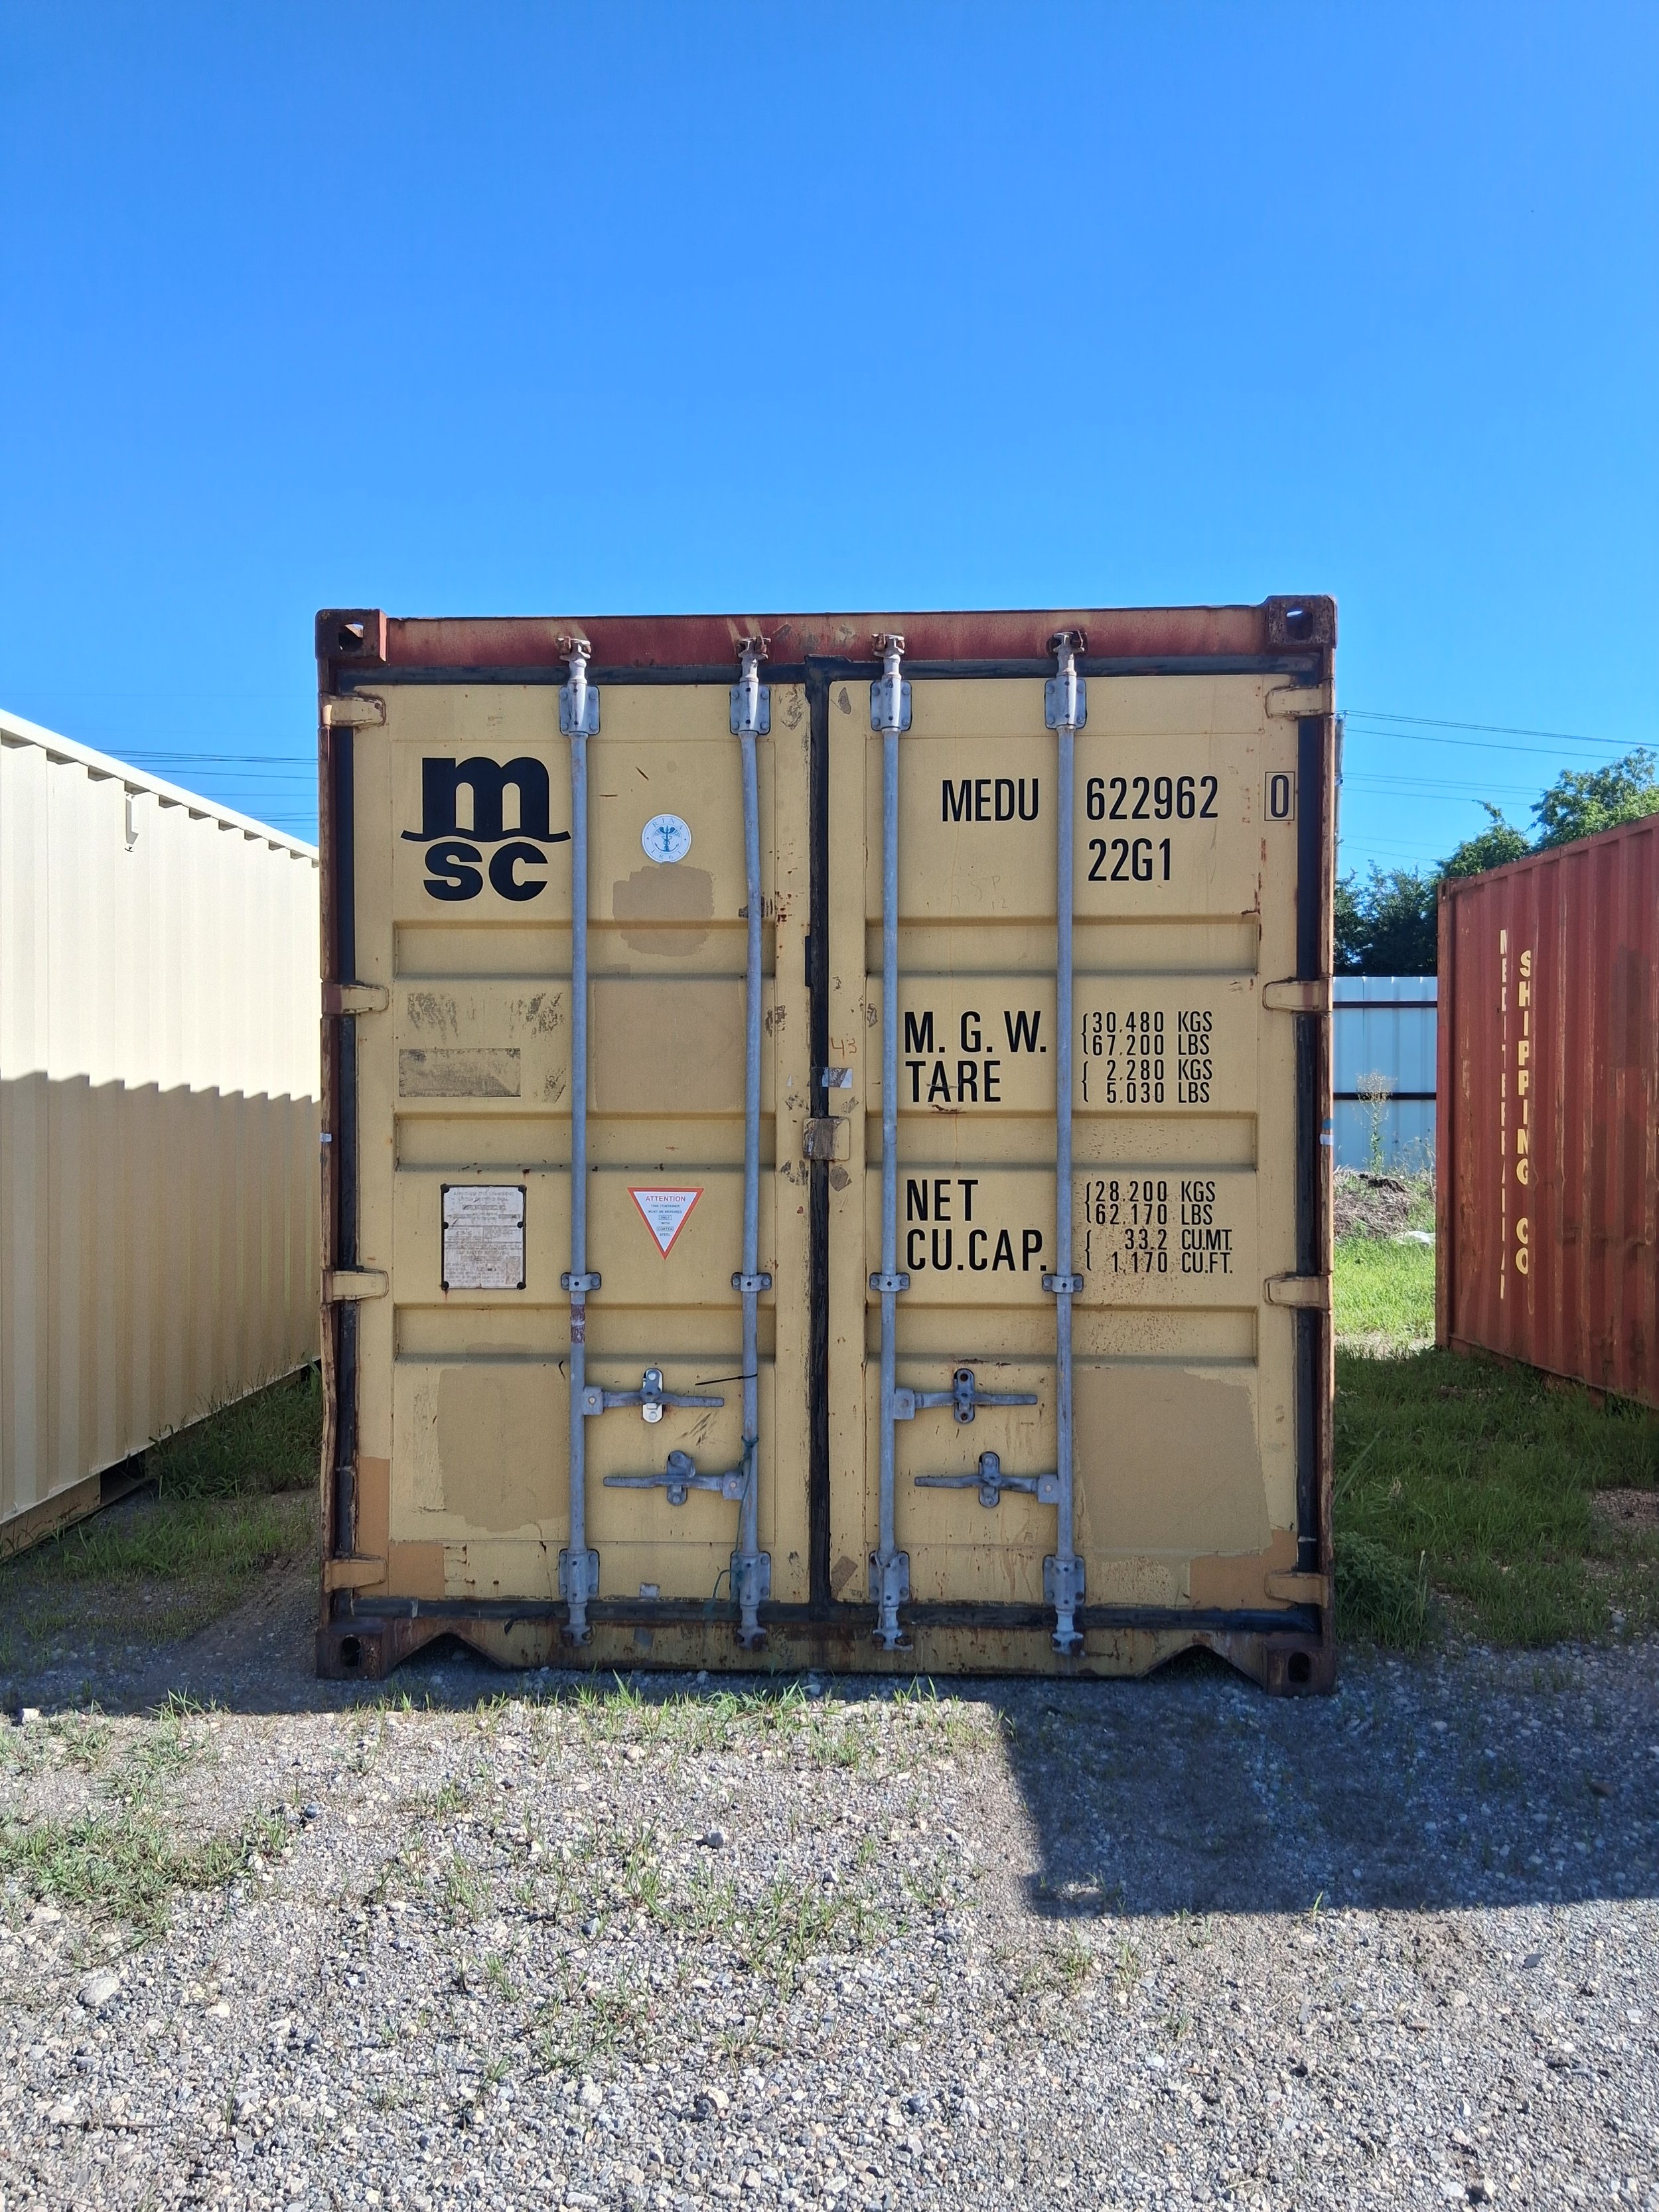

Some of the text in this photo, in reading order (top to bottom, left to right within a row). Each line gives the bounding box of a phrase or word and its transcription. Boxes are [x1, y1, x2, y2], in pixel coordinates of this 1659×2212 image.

[942, 774, 1289, 822] MEDU 622962 0
[652, 818, 684, 830] RINA
[1088, 838, 1171, 881] 22G1
[904, 1010, 1047, 1053] M. G. W.
[1178, 1011, 1213, 1033] KGS
[1178, 1033, 1210, 1055] LBS
[1178, 1059, 1213, 1080] KGS
[905, 1060, 1001, 1103] TARE
[1178, 1082, 1210, 1104] LBS
[906, 1179, 979, 1222] NET
[1181, 1181, 1216, 1203] KGS
[1181, 1203, 1214, 1225] LBS
[905, 1228, 1047, 1272] CU.CAP.
[1124, 1228, 1233, 1251] 33.2 CU.MT.
[1181, 1252, 1233, 1274] CU.FT.
